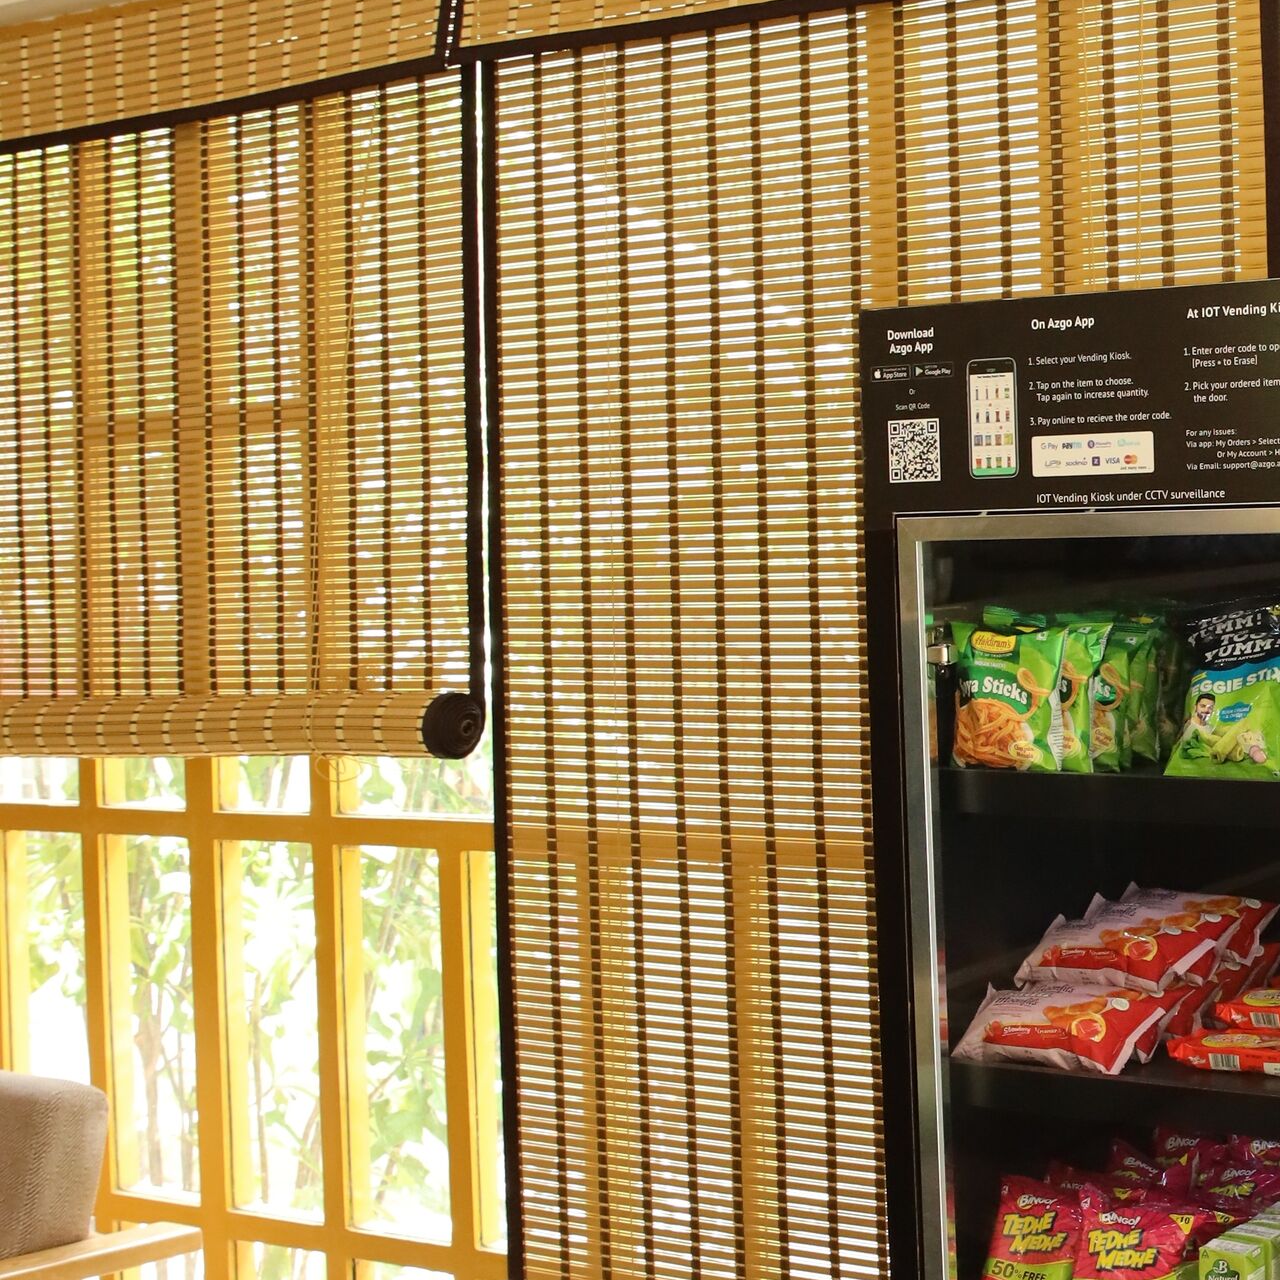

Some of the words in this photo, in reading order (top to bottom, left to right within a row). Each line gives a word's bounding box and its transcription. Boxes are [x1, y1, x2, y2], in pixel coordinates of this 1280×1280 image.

[1186, 308, 1199, 319] At
[1201, 306, 1221, 318] IOT
[1222, 304, 1267, 317] Vending
[1031, 319, 1045, 330] On
[1048, 318, 1072, 331] Azgo
[1074, 316, 1094, 328] App
[887, 327, 934, 340] Download
[889, 344, 912, 355] Azgo
[914, 342, 933, 354] App
[1192, 346, 1212, 355] Enter
[1214, 345, 1235, 354] order
[1237, 344, 1257, 353] code
[1258, 342, 1267, 351] to
[1036, 356, 1058, 365] Select
[1060, 355, 1076, 365] your
[1077, 353, 1107, 363] Vending
[1110, 351, 1132, 361] Kiosk.
[1223, 357, 1232, 366] to
[1233, 355, 1258, 366] Erase]
[1036, 381, 1049, 391] Tap
[1062, 380, 1075, 388] the
[1077, 379, 1093, 387] item
[1105, 377, 1133, 386] choose.
[1184, 382, 1192, 391] 2.
[1192, 381, 1209, 390] Pick
[1210, 381, 1227, 391] your
[1229, 379, 1261, 388] ordered
[1037, 393, 1050, 403] Tap
[1052, 392, 1072, 403] again
[1084, 390, 1114, 400] increase
[1117, 388, 1149, 399] quantity.
[1193, 394, 1207, 403] the
[1208, 393, 1228, 402] door.
[908, 403, 916, 411] QR
[917, 402, 930, 410] Code
[1038, 417, 1050, 426] Pay
[1052, 415, 1075, 425] online
[1087, 413, 1113, 423] recieve
[1115, 413, 1128, 422] the
[1130, 412, 1150, 421] order
[1151, 411, 1172, 420] code.
[1185, 429, 1197, 437] For
[1198, 429, 1212, 438] any
[1186, 440, 1197, 448] Via
[1199, 441, 1214, 449] app:
[1216, 439, 1226, 448] My
[1227, 439, 1250, 447] Orders
[1258, 437, 1280, 446] Select
[1105, 457, 1120, 465] VISA
[1216, 450, 1225, 458] Or
[1226, 450, 1238, 459] My
[1238, 449, 1267, 458] Account
[1199, 462, 1221, 470] Email:
[1036, 493, 1051, 503] IOT
[1052, 492, 1089, 504] Vending
[1090, 491, 1115, 502] Kiosk
[1116, 490, 1142, 501] under
[1144, 489, 1168, 500] CCTV
[1170, 488, 1226, 499] surveillance
[975, 635, 1011, 649] Haldiram's
[982, 676, 1028, 705] Sticks
[1003, 1211, 1057, 1236] TEDHE
[1008, 1232, 1068, 1255] MEDHE
[1088, 1229, 1142, 1254] TEDHE
[1096, 1248, 1158, 1271] MEDHE
